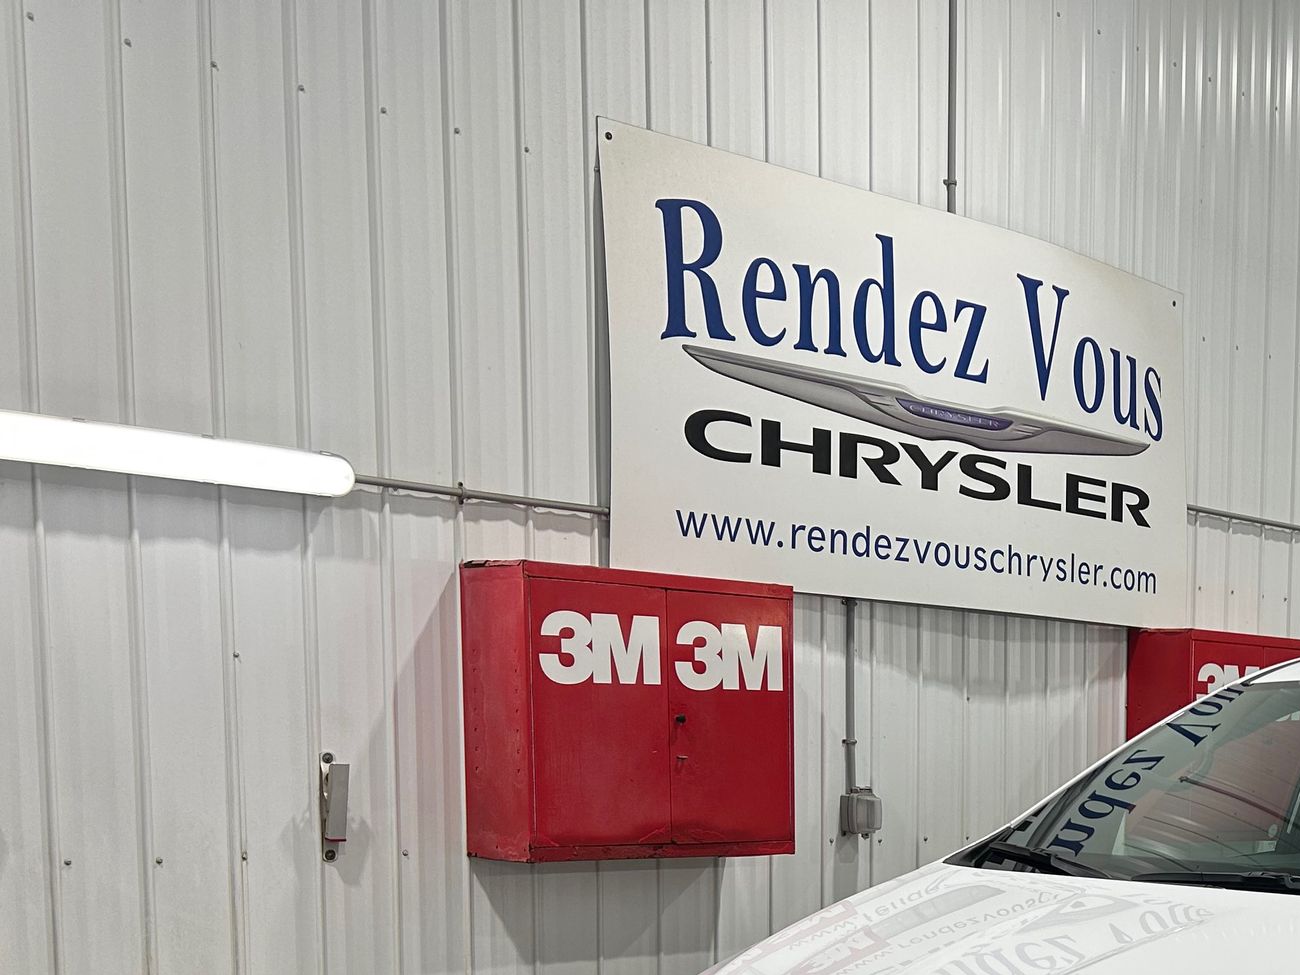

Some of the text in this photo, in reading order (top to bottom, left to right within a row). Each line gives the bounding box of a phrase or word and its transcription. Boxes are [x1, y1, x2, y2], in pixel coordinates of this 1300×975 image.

[655, 198, 1164, 443] Rendez Vous
[684, 408, 1151, 528] CHRYSLER
[676, 508, 1157, 594] www.rendezvouschrysler.com
[538, 610, 662, 685] 3M
[674, 620, 784, 692] 3M
